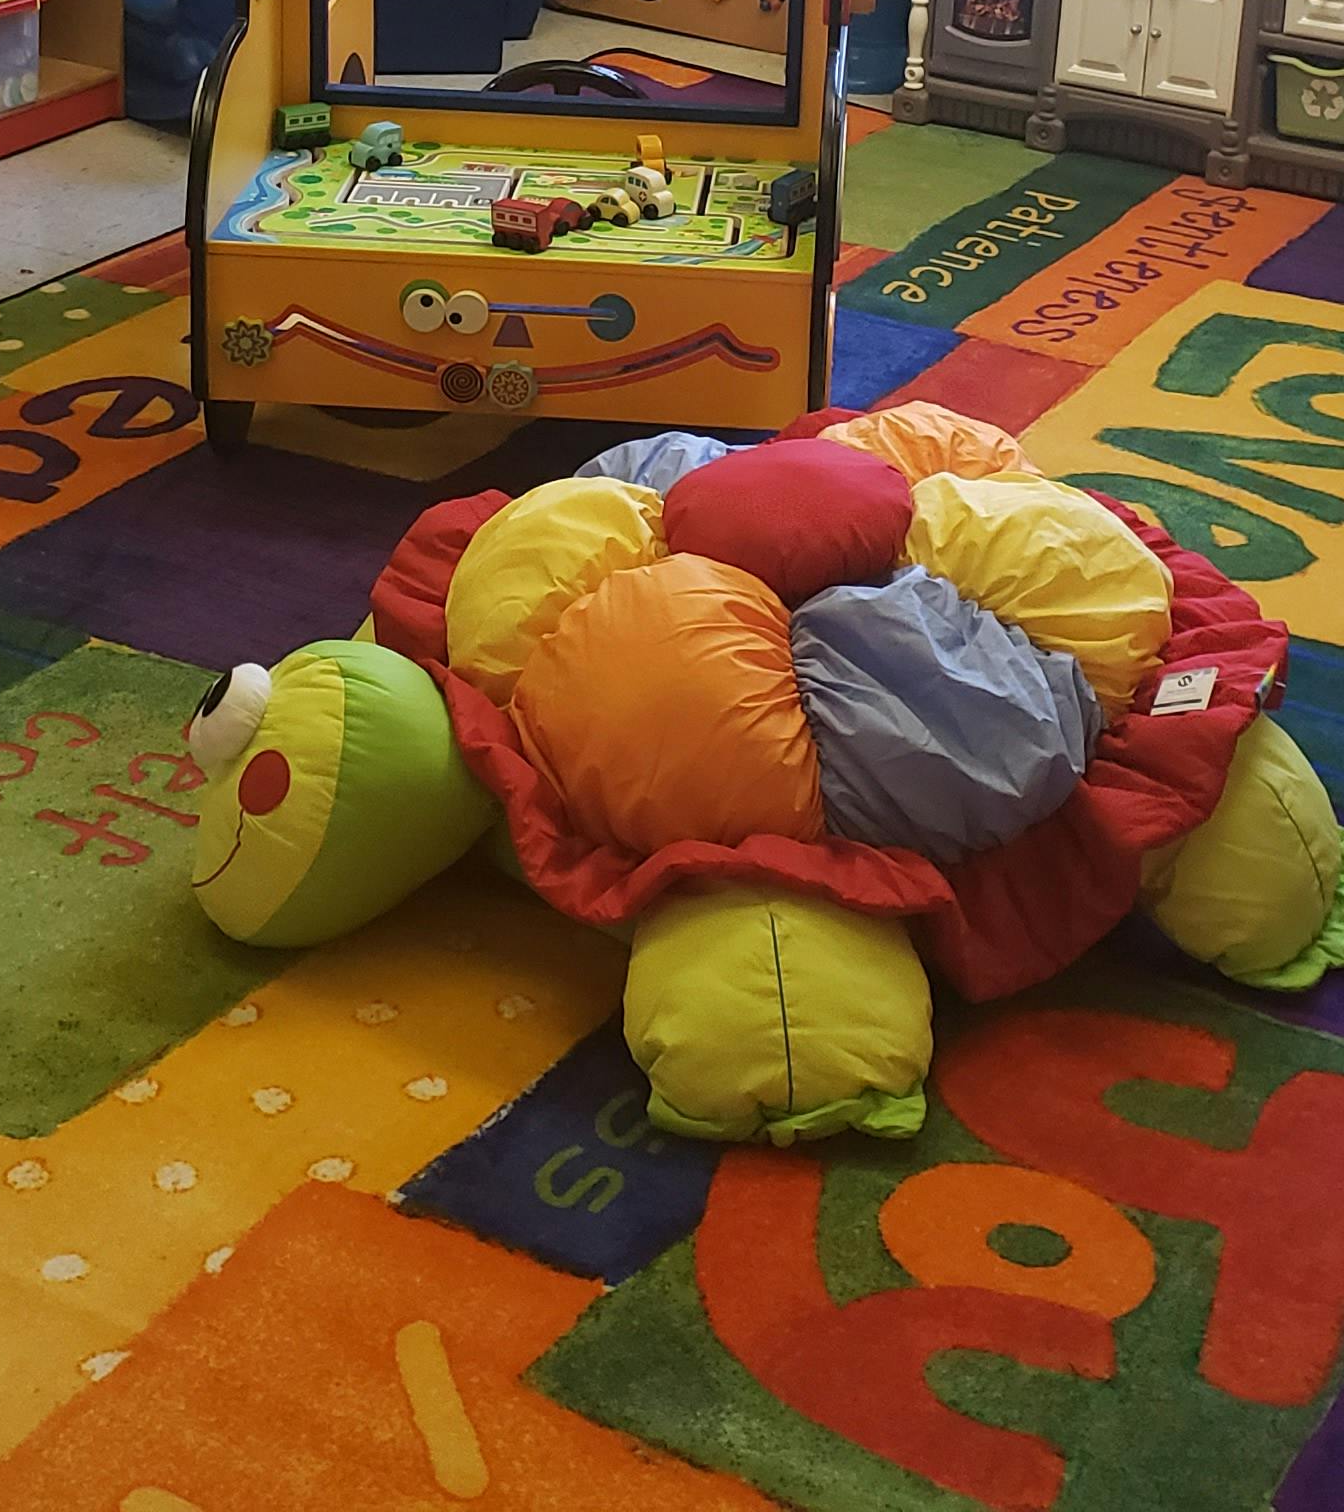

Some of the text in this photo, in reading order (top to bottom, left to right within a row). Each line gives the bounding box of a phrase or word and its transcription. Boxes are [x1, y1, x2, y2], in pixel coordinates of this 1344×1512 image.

[880, 190, 1079, 305] patience
[1011, 186, 1256, 344] gentleness
[36, 751, 208, 868] elf
